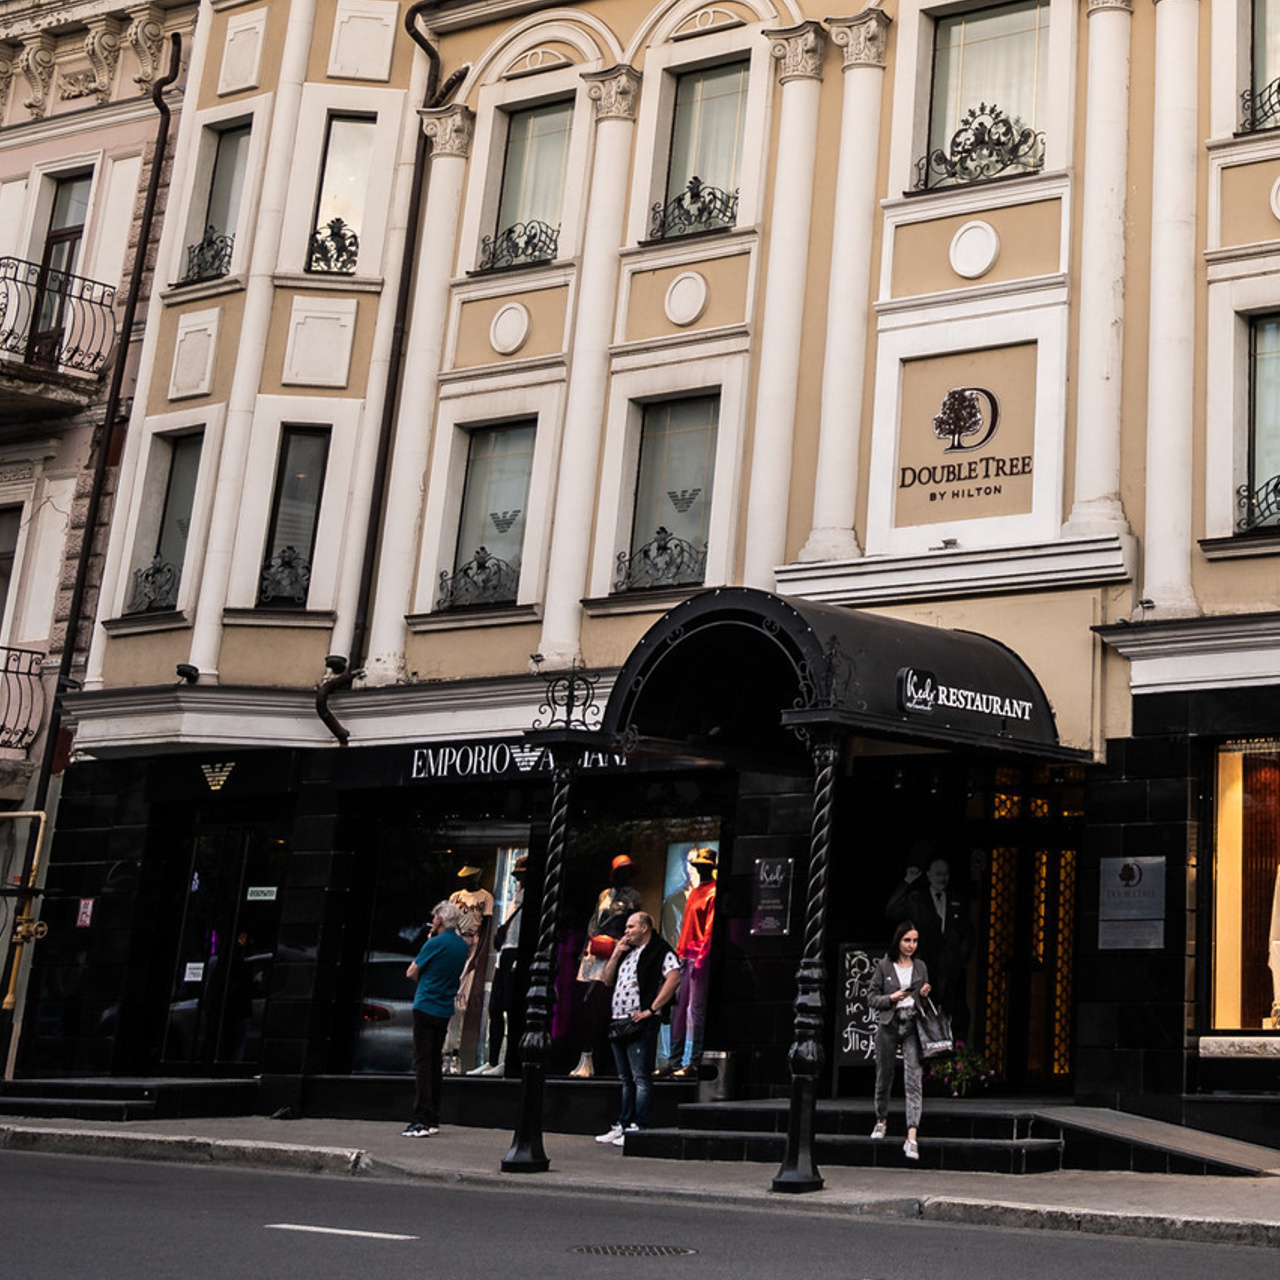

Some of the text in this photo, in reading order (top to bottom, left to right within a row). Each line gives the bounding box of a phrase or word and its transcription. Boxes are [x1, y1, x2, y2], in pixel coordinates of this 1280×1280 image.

[899, 455, 1033, 489] DOUBLETREE
[929, 485, 1002, 502] BY HILTON
[937, 685, 1033, 720] RESTAURANT
[411, 743, 511, 778] EMPORIO
